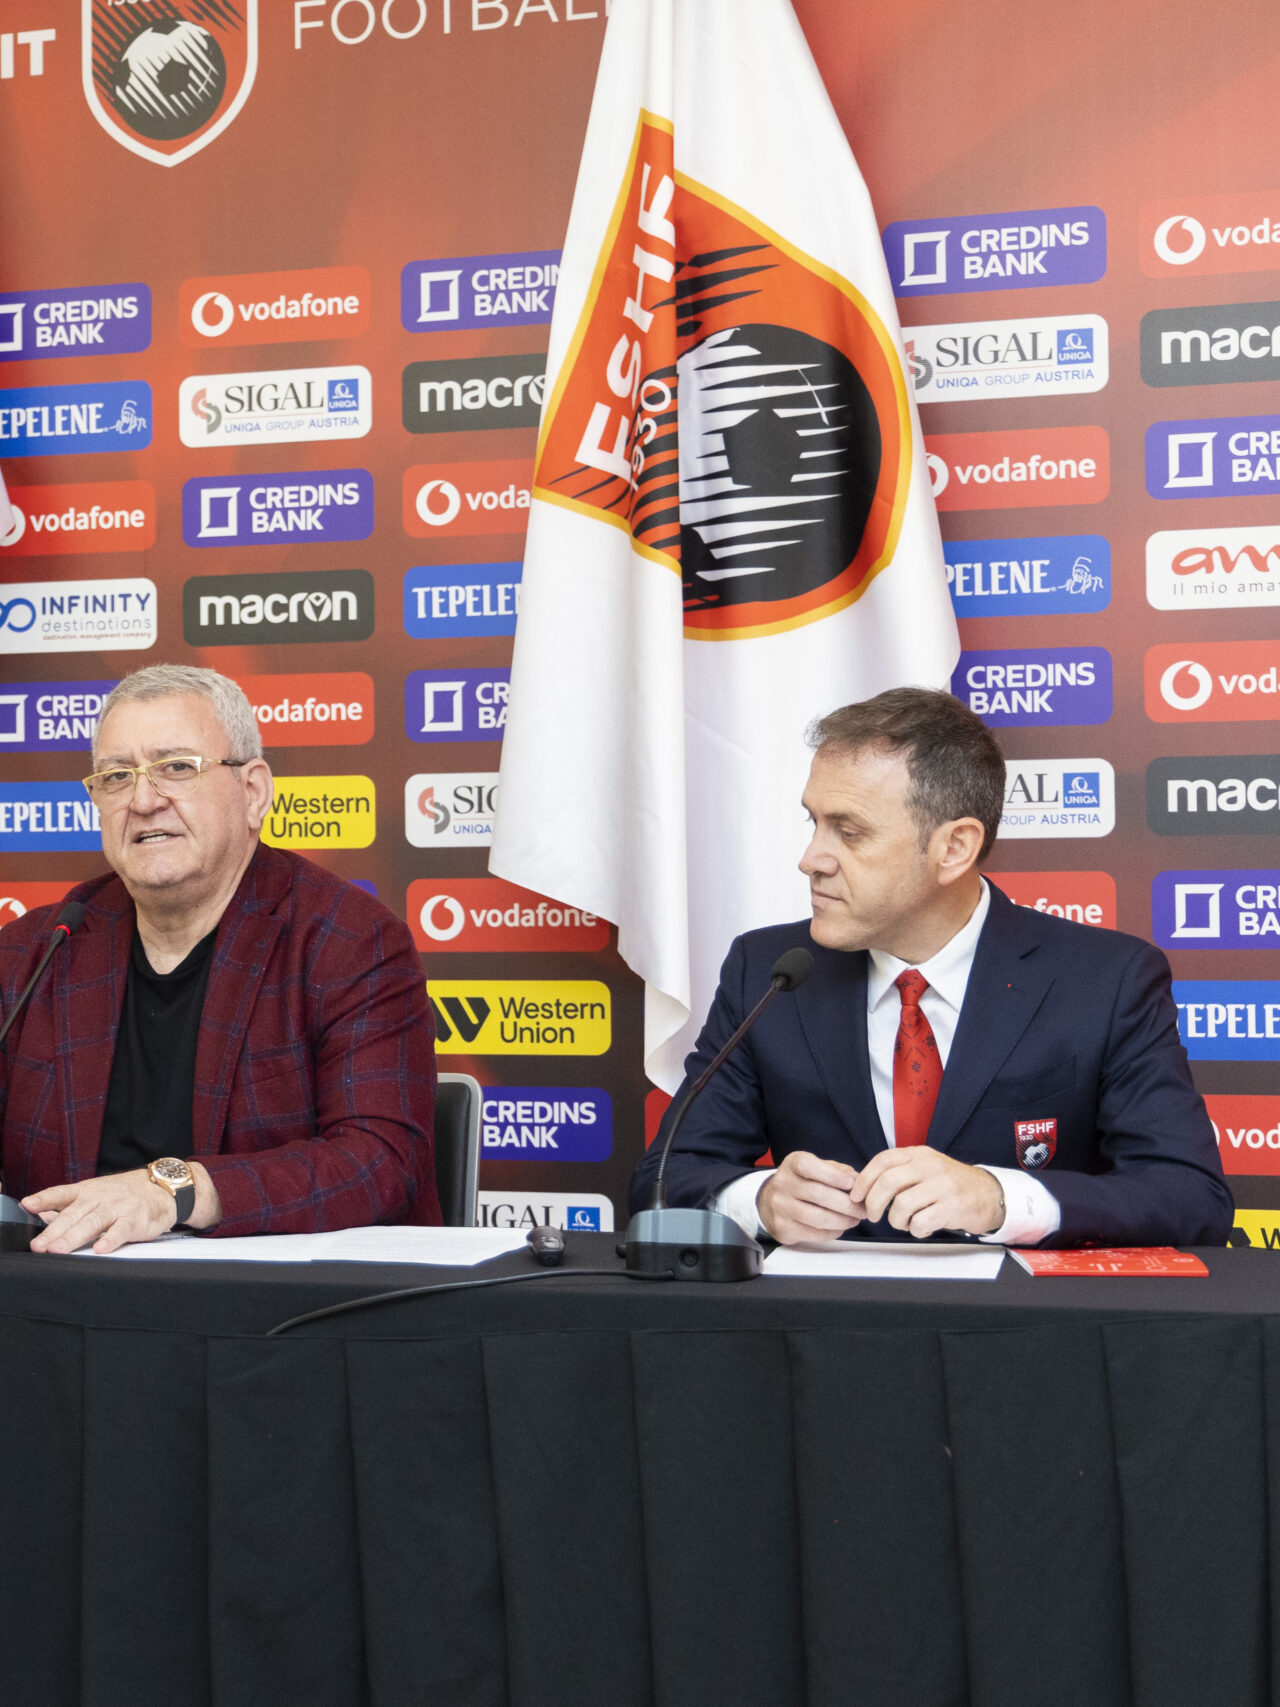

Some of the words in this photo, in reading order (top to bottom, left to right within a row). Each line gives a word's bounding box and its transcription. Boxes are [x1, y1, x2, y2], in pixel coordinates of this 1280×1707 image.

[295, 0, 610, 49] FOOTBA
[960, 221, 1089, 254] CREDINS
[963, 250, 1048, 279] BANK
[33, 296, 138, 324] CREDINS
[238, 293, 360, 322] vodafone
[474, 290, 550, 317] BANK
[35, 322, 104, 348] BANK
[936, 331, 1053, 367] SIGAL
[1058, 351, 1093, 362] UNIQA
[936, 375, 979, 389] UNIQA
[984, 373, 1030, 387] GROUP
[1035, 369, 1094, 383] AUSTRIA
[224, 381, 324, 415] SIGAL
[329, 399, 358, 410] UNIQA
[224, 422, 261, 434] UNIQA
[265, 419, 305, 432] GROUP
[308, 416, 360, 429] AUSTRIA
[955, 455, 1096, 485] vodafone
[249, 482, 360, 511] CREDINS
[30, 506, 145, 533] vodafone
[251, 508, 324, 534] BANK
[1171, 544, 1280, 576] am
[412, 583, 522, 619] TEPELE
[1193, 581, 1228, 596] mio
[1237, 581, 1280, 594] ama
[42, 593, 151, 615] INFINITY
[199, 590, 358, 627] macron
[41, 616, 152, 633] destinations
[966, 662, 1096, 690] CREDINS
[969, 689, 1053, 716] BANK
[272, 792, 370, 815] Western
[1065, 795, 1098, 805] UNIQA
[271, 816, 341, 839] Union
[453, 824, 492, 834] UNIQA
[1040, 813, 1100, 825] AUSTRIA
[471, 903, 597, 928] vodafone
[498, 996, 606, 1020] Western
[500, 1021, 575, 1045] Union
[483, 1101, 597, 1125] CREDINS
[483, 1125, 559, 1149] BANK
[1017, 1121, 1055, 1135] FSHF
[476, 1204, 565, 1228] IGAL
